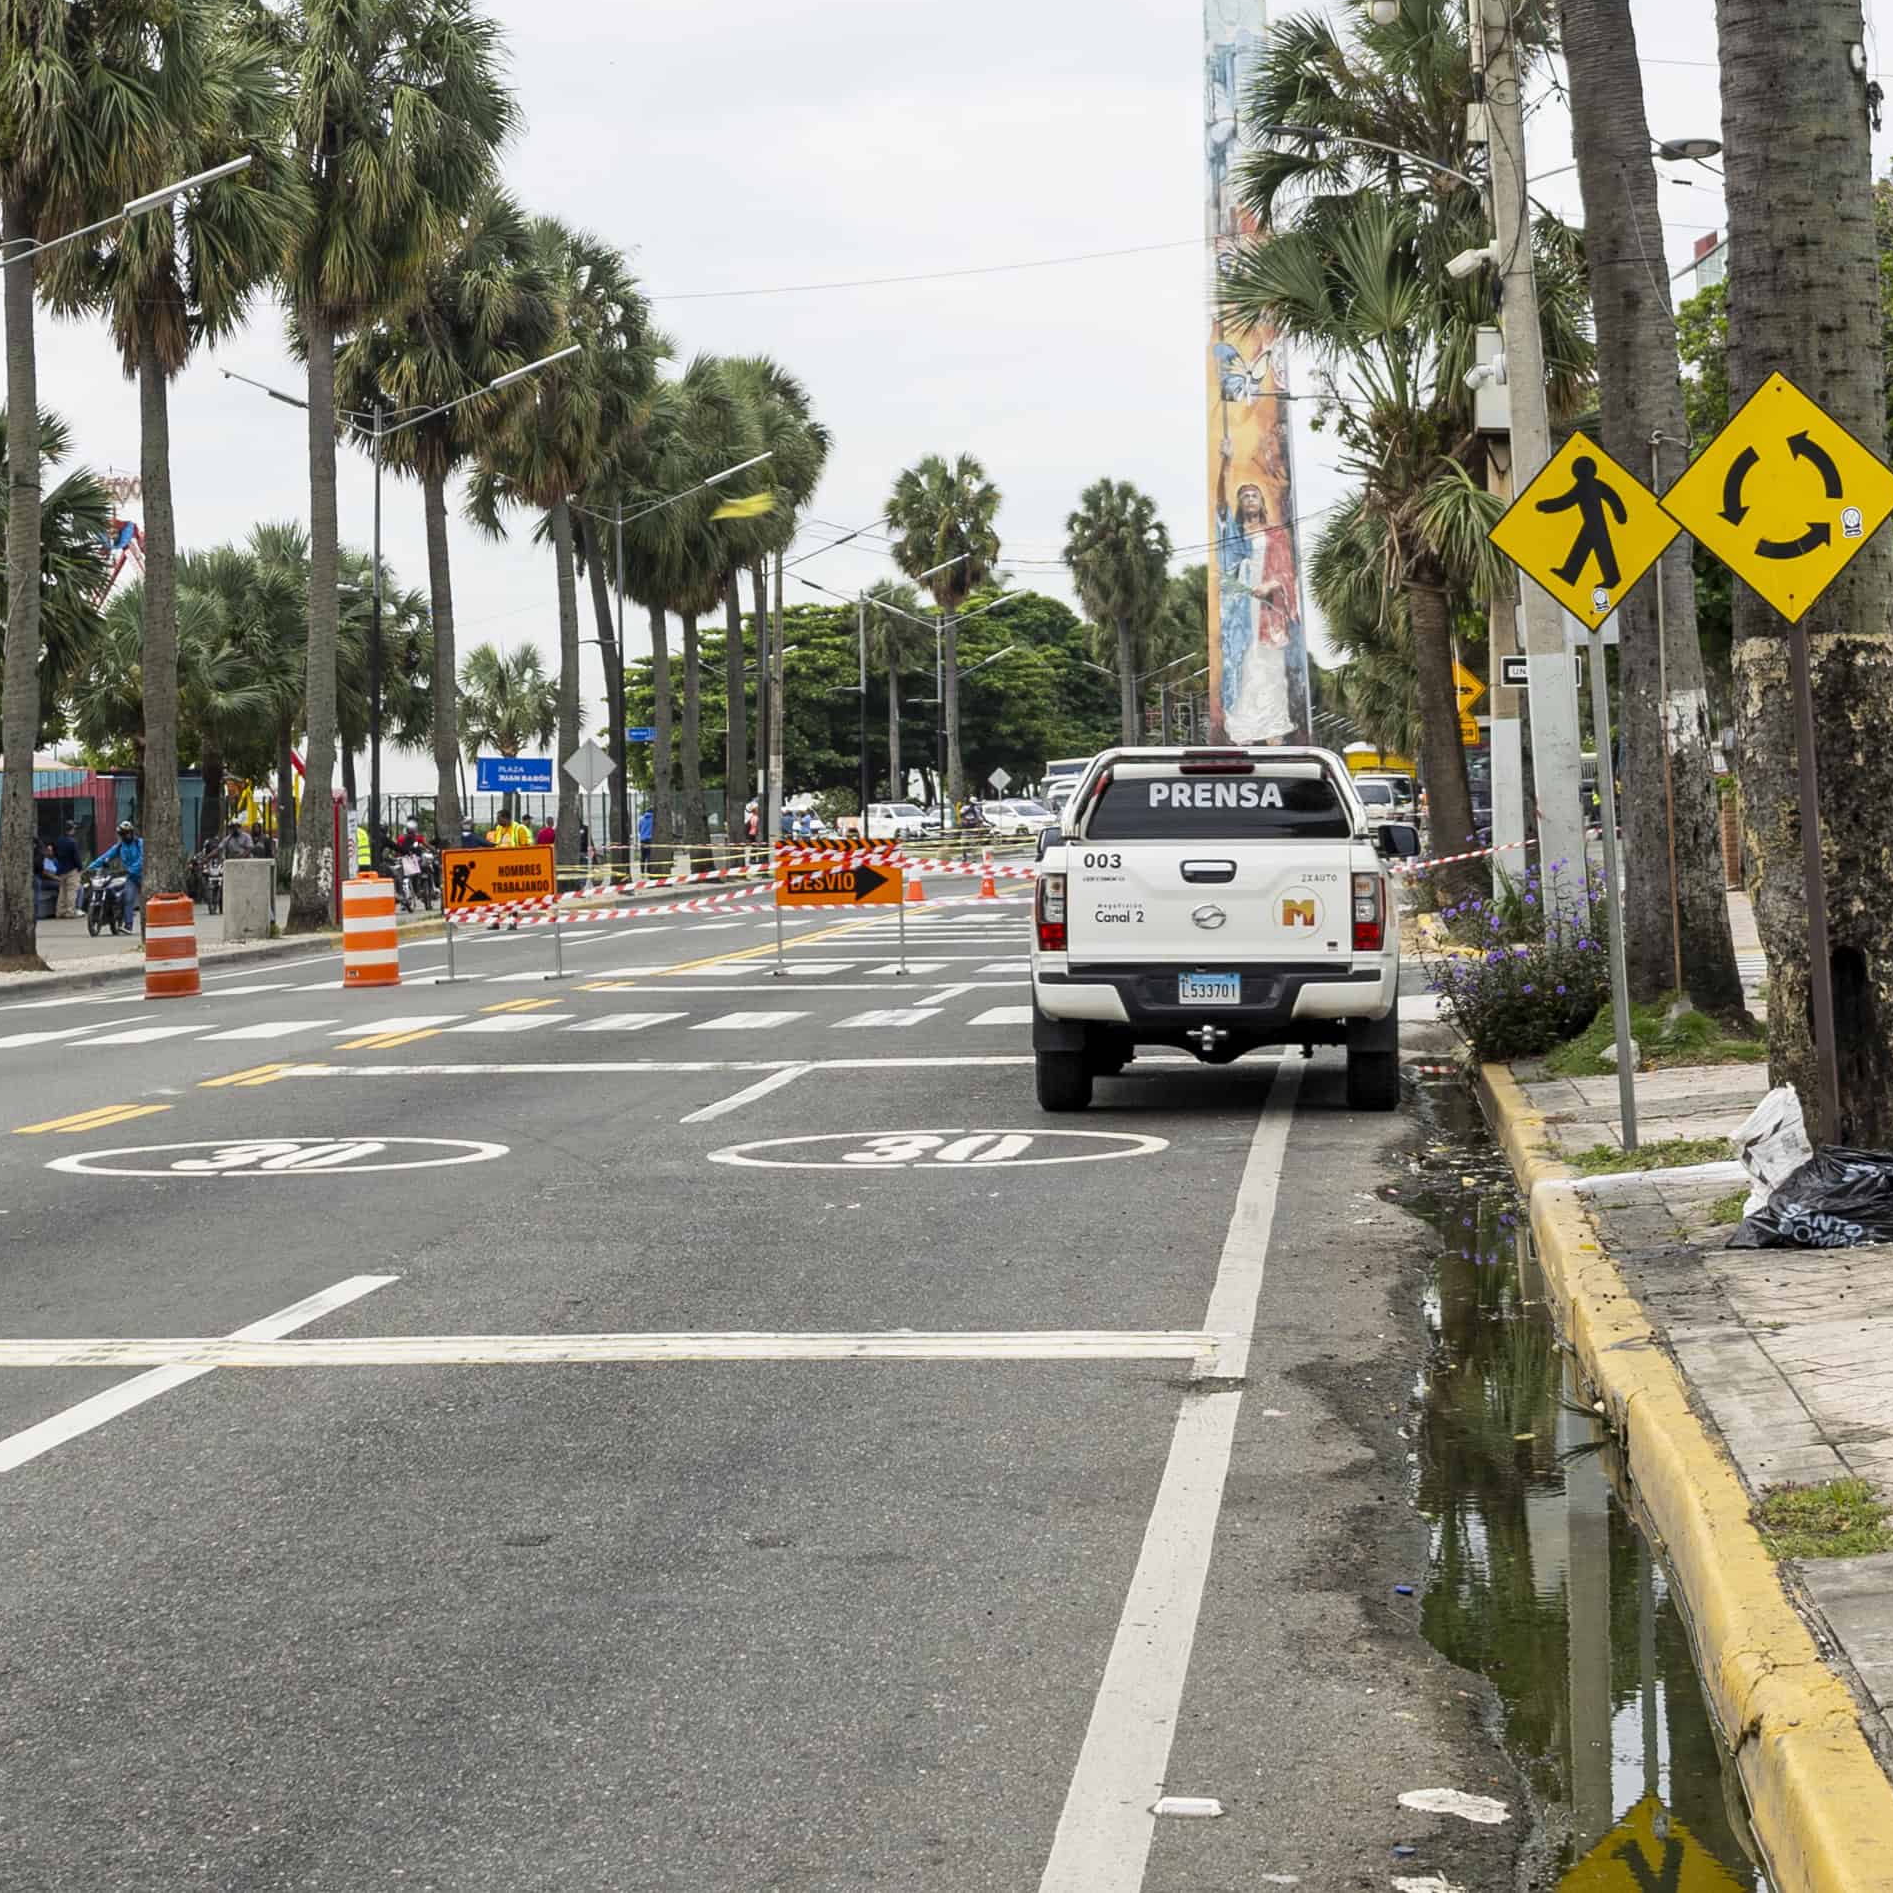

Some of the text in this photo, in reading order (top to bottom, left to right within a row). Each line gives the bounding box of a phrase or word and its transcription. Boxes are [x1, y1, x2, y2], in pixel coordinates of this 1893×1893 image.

[1149, 782, 1284, 808] PRENSA
[1084, 853, 1122, 868] 003
[498, 863, 542, 878] HOMBRES
[491, 880, 550, 894] TRABAJANDO
[1095, 910, 1145, 923] Canal 2
[1182, 984, 1235, 998] L533701
[841, 1134, 1034, 1162] 30
[171, 1142, 387, 1171] 30
